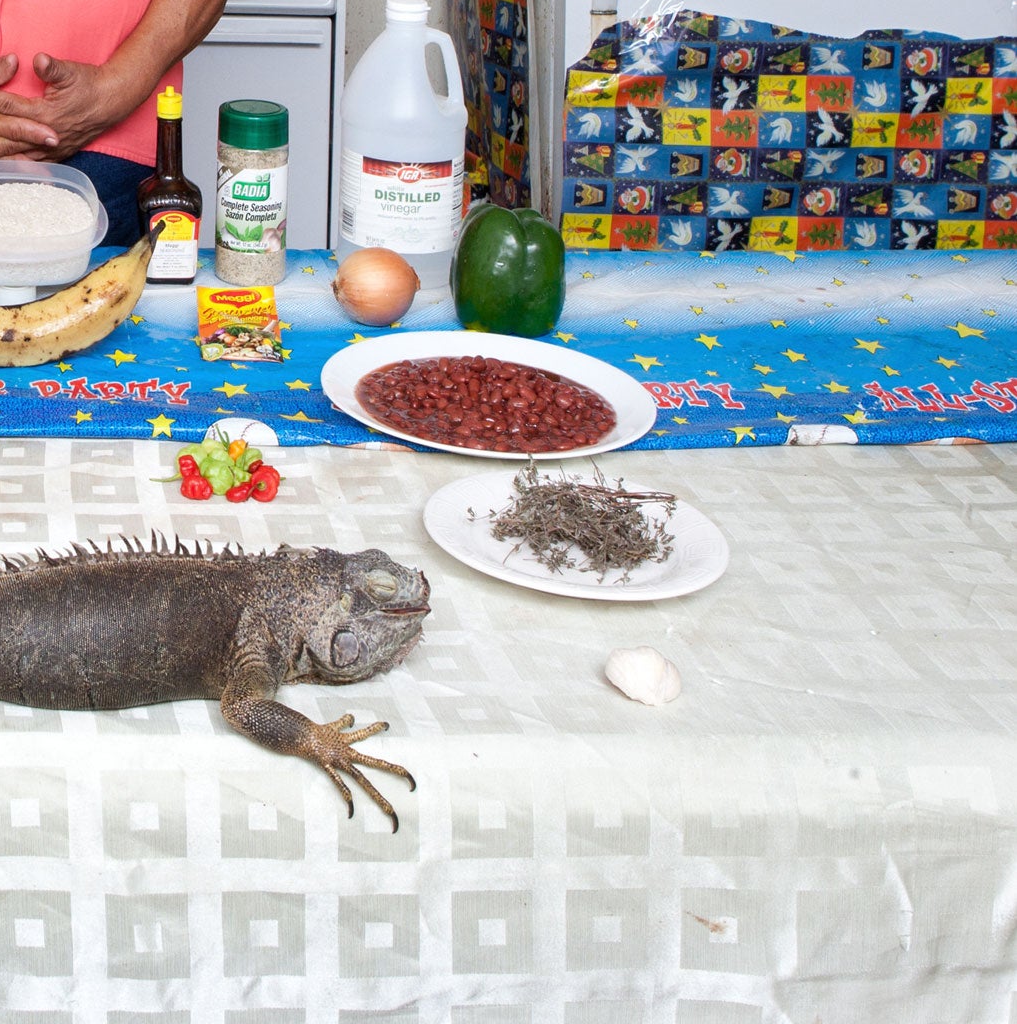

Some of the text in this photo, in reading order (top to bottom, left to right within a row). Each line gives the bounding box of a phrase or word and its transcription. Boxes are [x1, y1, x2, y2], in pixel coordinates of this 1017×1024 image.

[400, 170, 419, 180] IGA
[234, 184, 268, 197] BADIA
[374, 189, 441, 203] DISTILLED
[220, 197, 283, 213] Complete Seasoning
[381, 202, 422, 216] vinegar
[225, 209, 277, 224] Sazón Completa
[29, 376, 191, 405] PARTY
[641, 378, 745, 410] RTY
